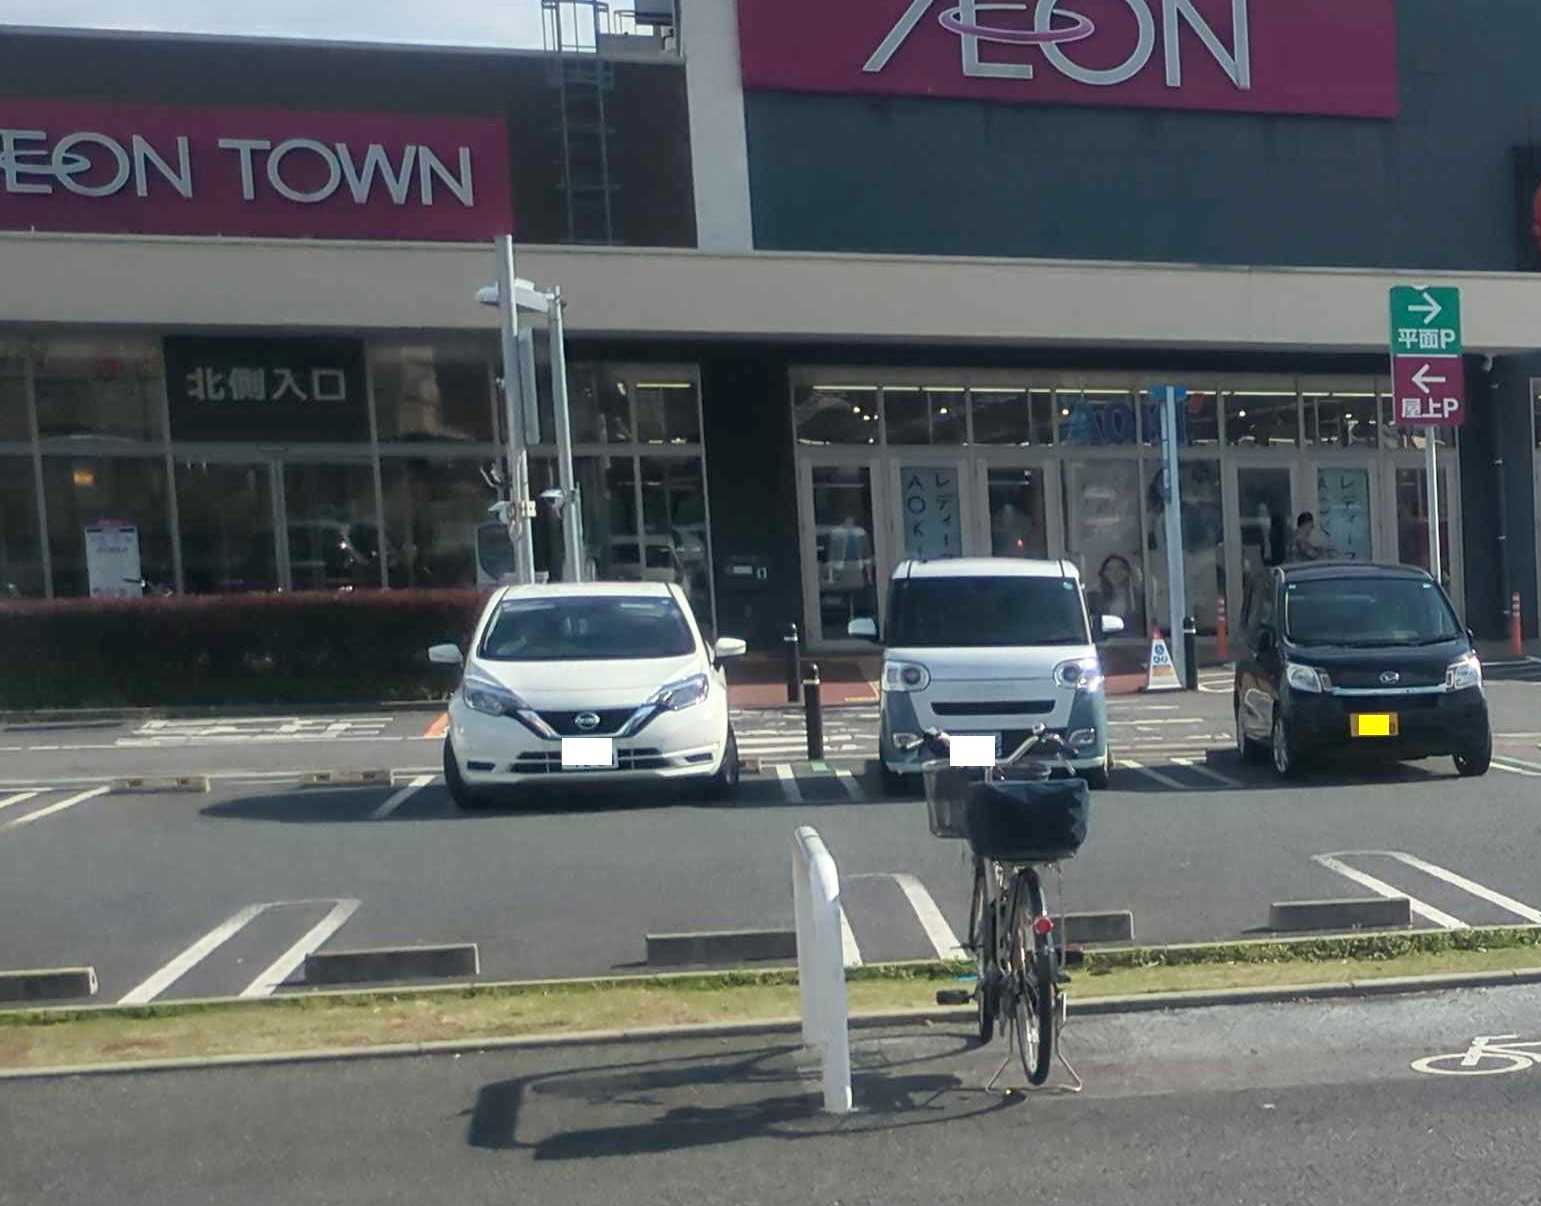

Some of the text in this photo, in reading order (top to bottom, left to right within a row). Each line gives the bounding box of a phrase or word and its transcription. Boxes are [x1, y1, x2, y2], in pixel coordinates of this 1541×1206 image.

[0, 129, 474, 207] EON TOWN
[1398, 328, 1456, 351] 平面P
[186, 366, 347, 404] 北側入口
[1401, 397, 1460, 420] 屋上P
